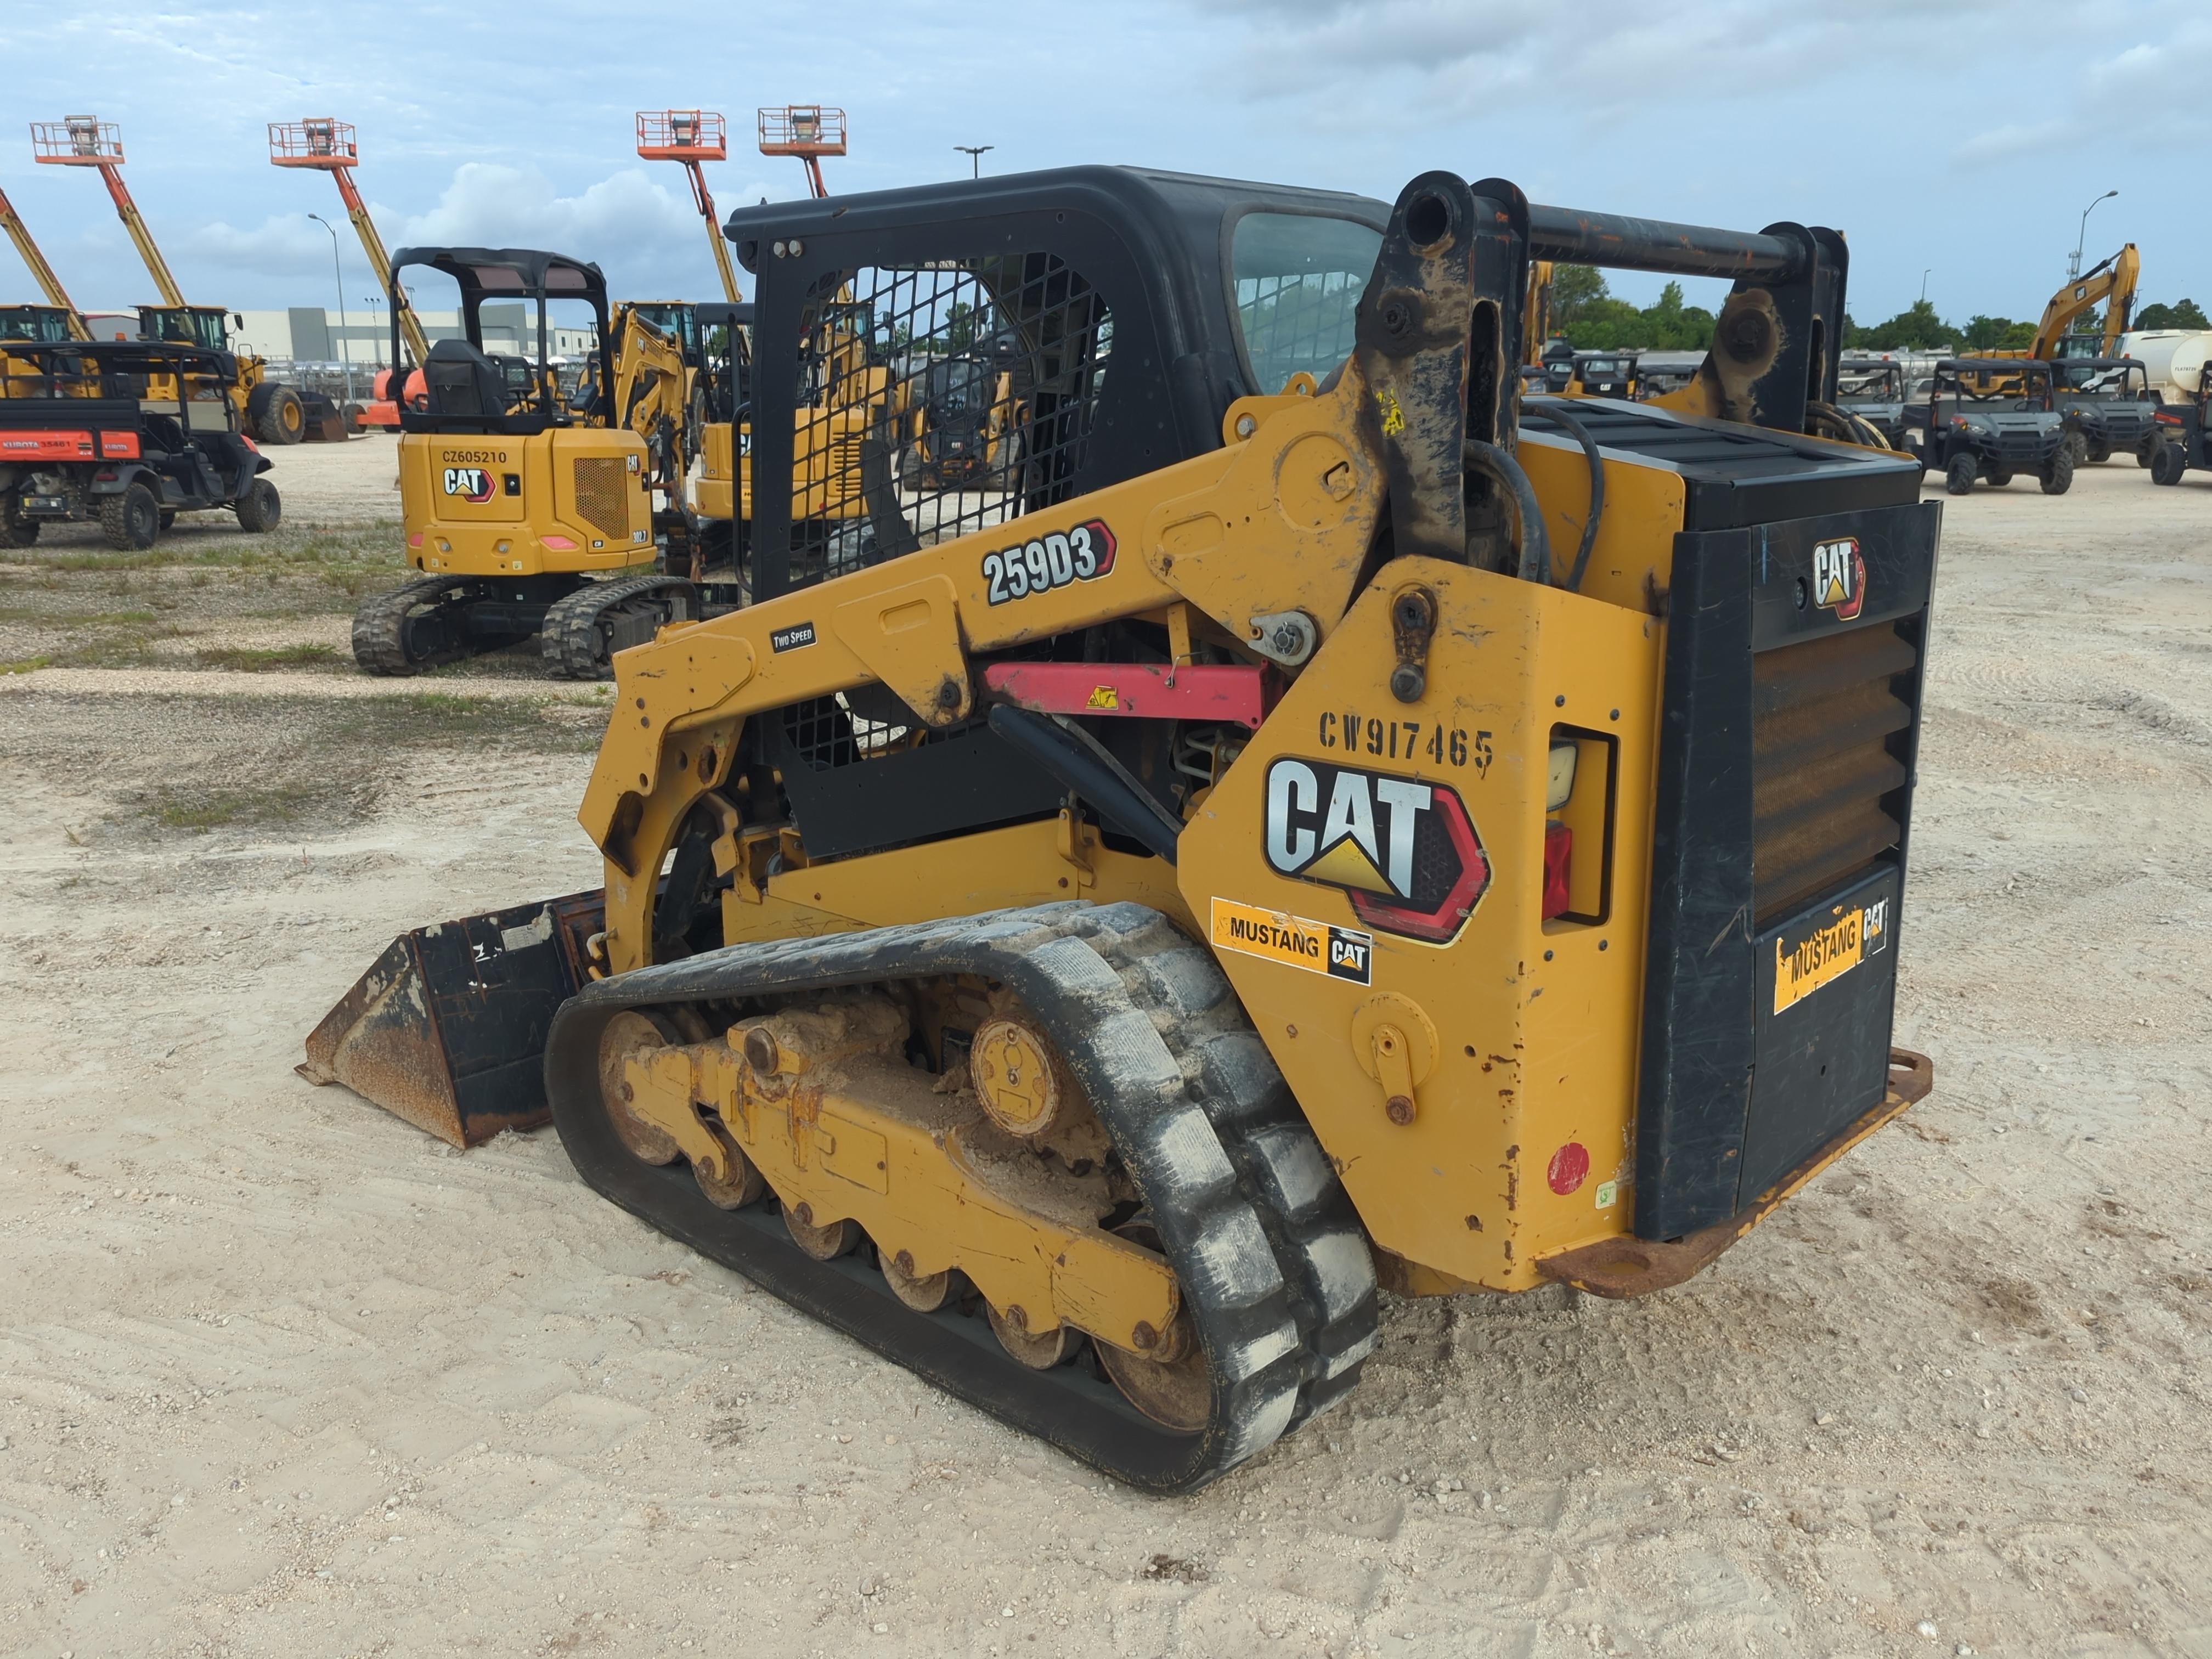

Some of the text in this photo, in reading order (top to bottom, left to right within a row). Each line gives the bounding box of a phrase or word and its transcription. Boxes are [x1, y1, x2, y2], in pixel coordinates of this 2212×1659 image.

[443, 450, 507, 463] CZ605210
[444, 469, 481, 495] CAT
[627, 455, 638, 472] CAT
[984, 527, 1096, 603] 259D3
[1814, 541, 1852, 604] CAT
[1319, 712, 1493, 769] CW917465
[1268, 760, 1431, 899] CAT
[1231, 917, 1365, 970] MUSTANG CAT
[1791, 900, 1886, 984] MUSTANG CAT
